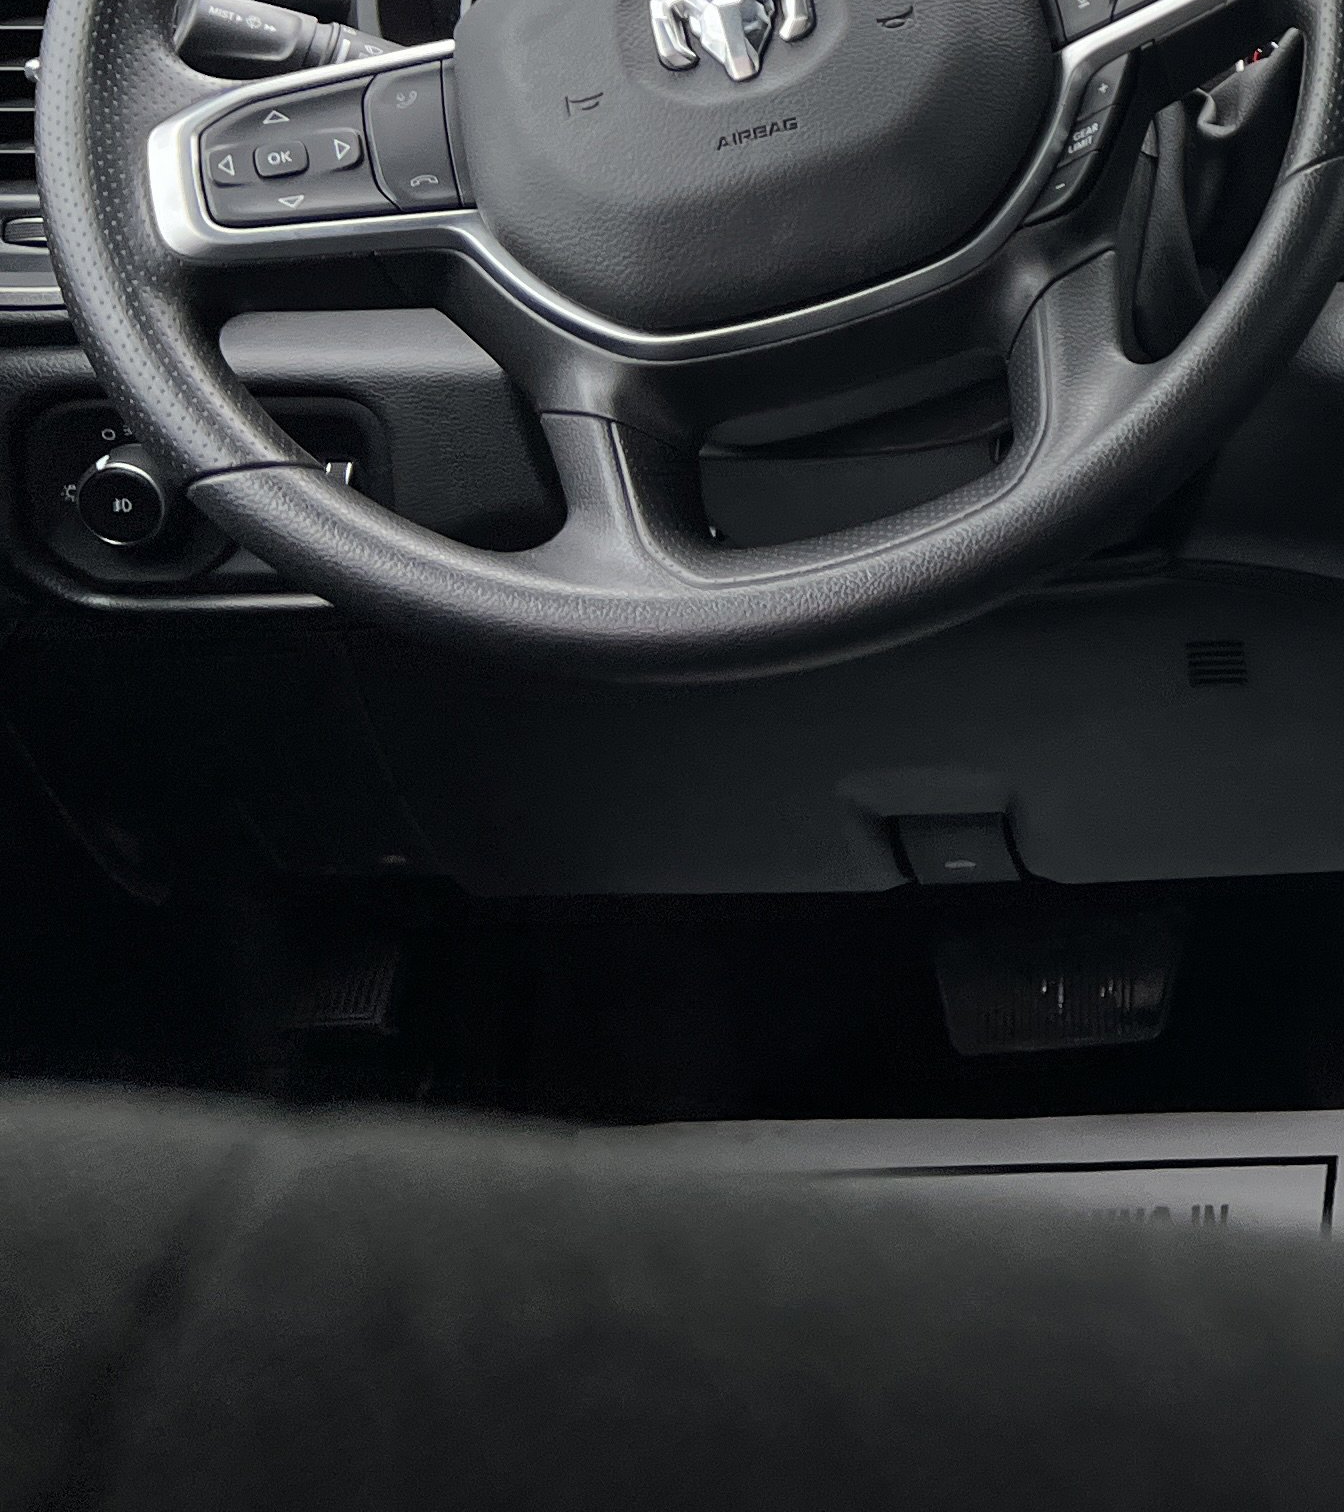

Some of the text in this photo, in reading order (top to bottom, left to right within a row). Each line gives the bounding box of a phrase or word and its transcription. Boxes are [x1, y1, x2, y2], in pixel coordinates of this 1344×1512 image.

[208, 5, 235, 23] MIST
[717, 116, 799, 151] AIRBAG
[1072, 122, 1099, 142] GEAR
[1067, 135, 1094, 154] LIMIT
[267, 149, 293, 165] OK
